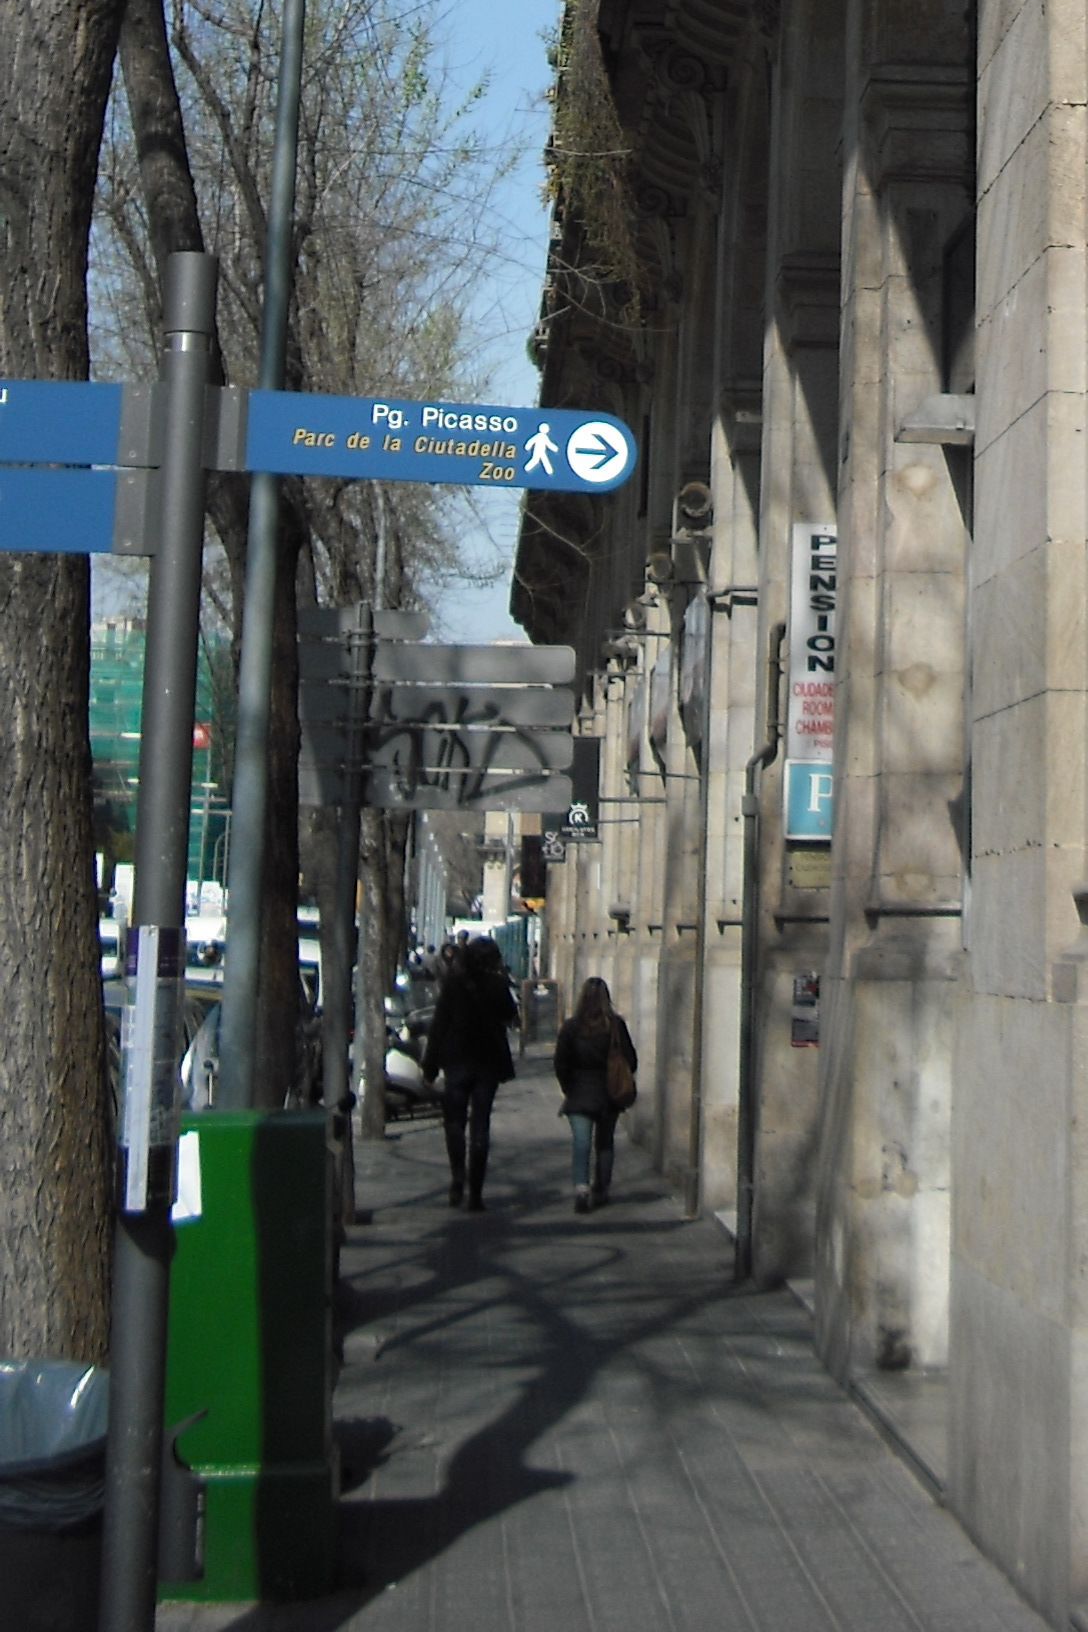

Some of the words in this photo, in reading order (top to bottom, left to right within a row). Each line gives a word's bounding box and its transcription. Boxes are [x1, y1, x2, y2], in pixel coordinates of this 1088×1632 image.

[371, 403, 409, 429] Pg.
[422, 406, 518, 433] Picasso
[292, 427, 336, 448] Parc
[346, 431, 371, 450] de
[383, 434, 402, 452] la
[414, 435, 517, 459] Ciutadella
[478, 461, 516, 481] Zoo
[806, 533, 838, 673] PENSION
